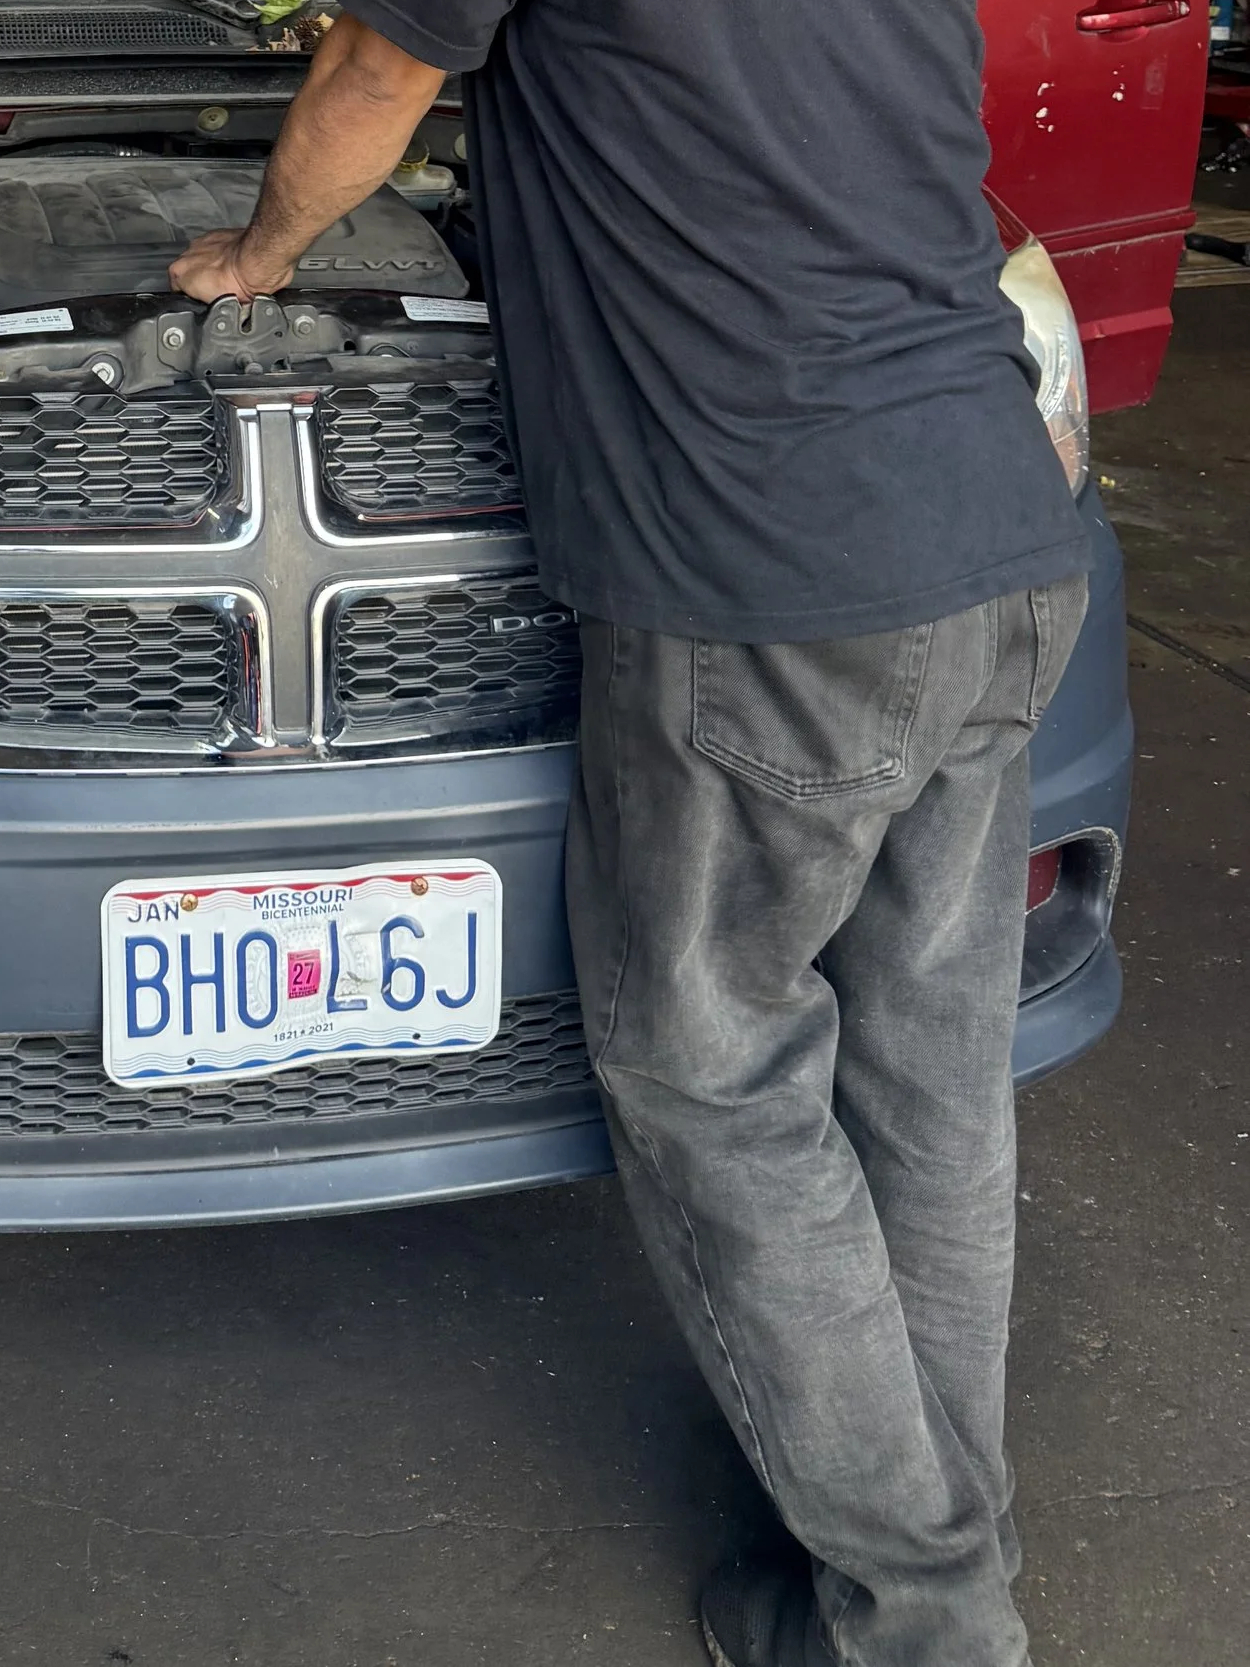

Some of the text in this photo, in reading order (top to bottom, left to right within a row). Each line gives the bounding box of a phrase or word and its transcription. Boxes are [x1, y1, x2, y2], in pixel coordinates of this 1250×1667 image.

[253, 887, 353, 910] MISSOURI
[128, 900, 180, 923] JAN
[261, 903, 344, 920] BICENTENNIAL
[292, 961, 315, 986] 27
[326, 911, 477, 1014] L6J
[274, 1022, 334, 1042] 1821 2021
